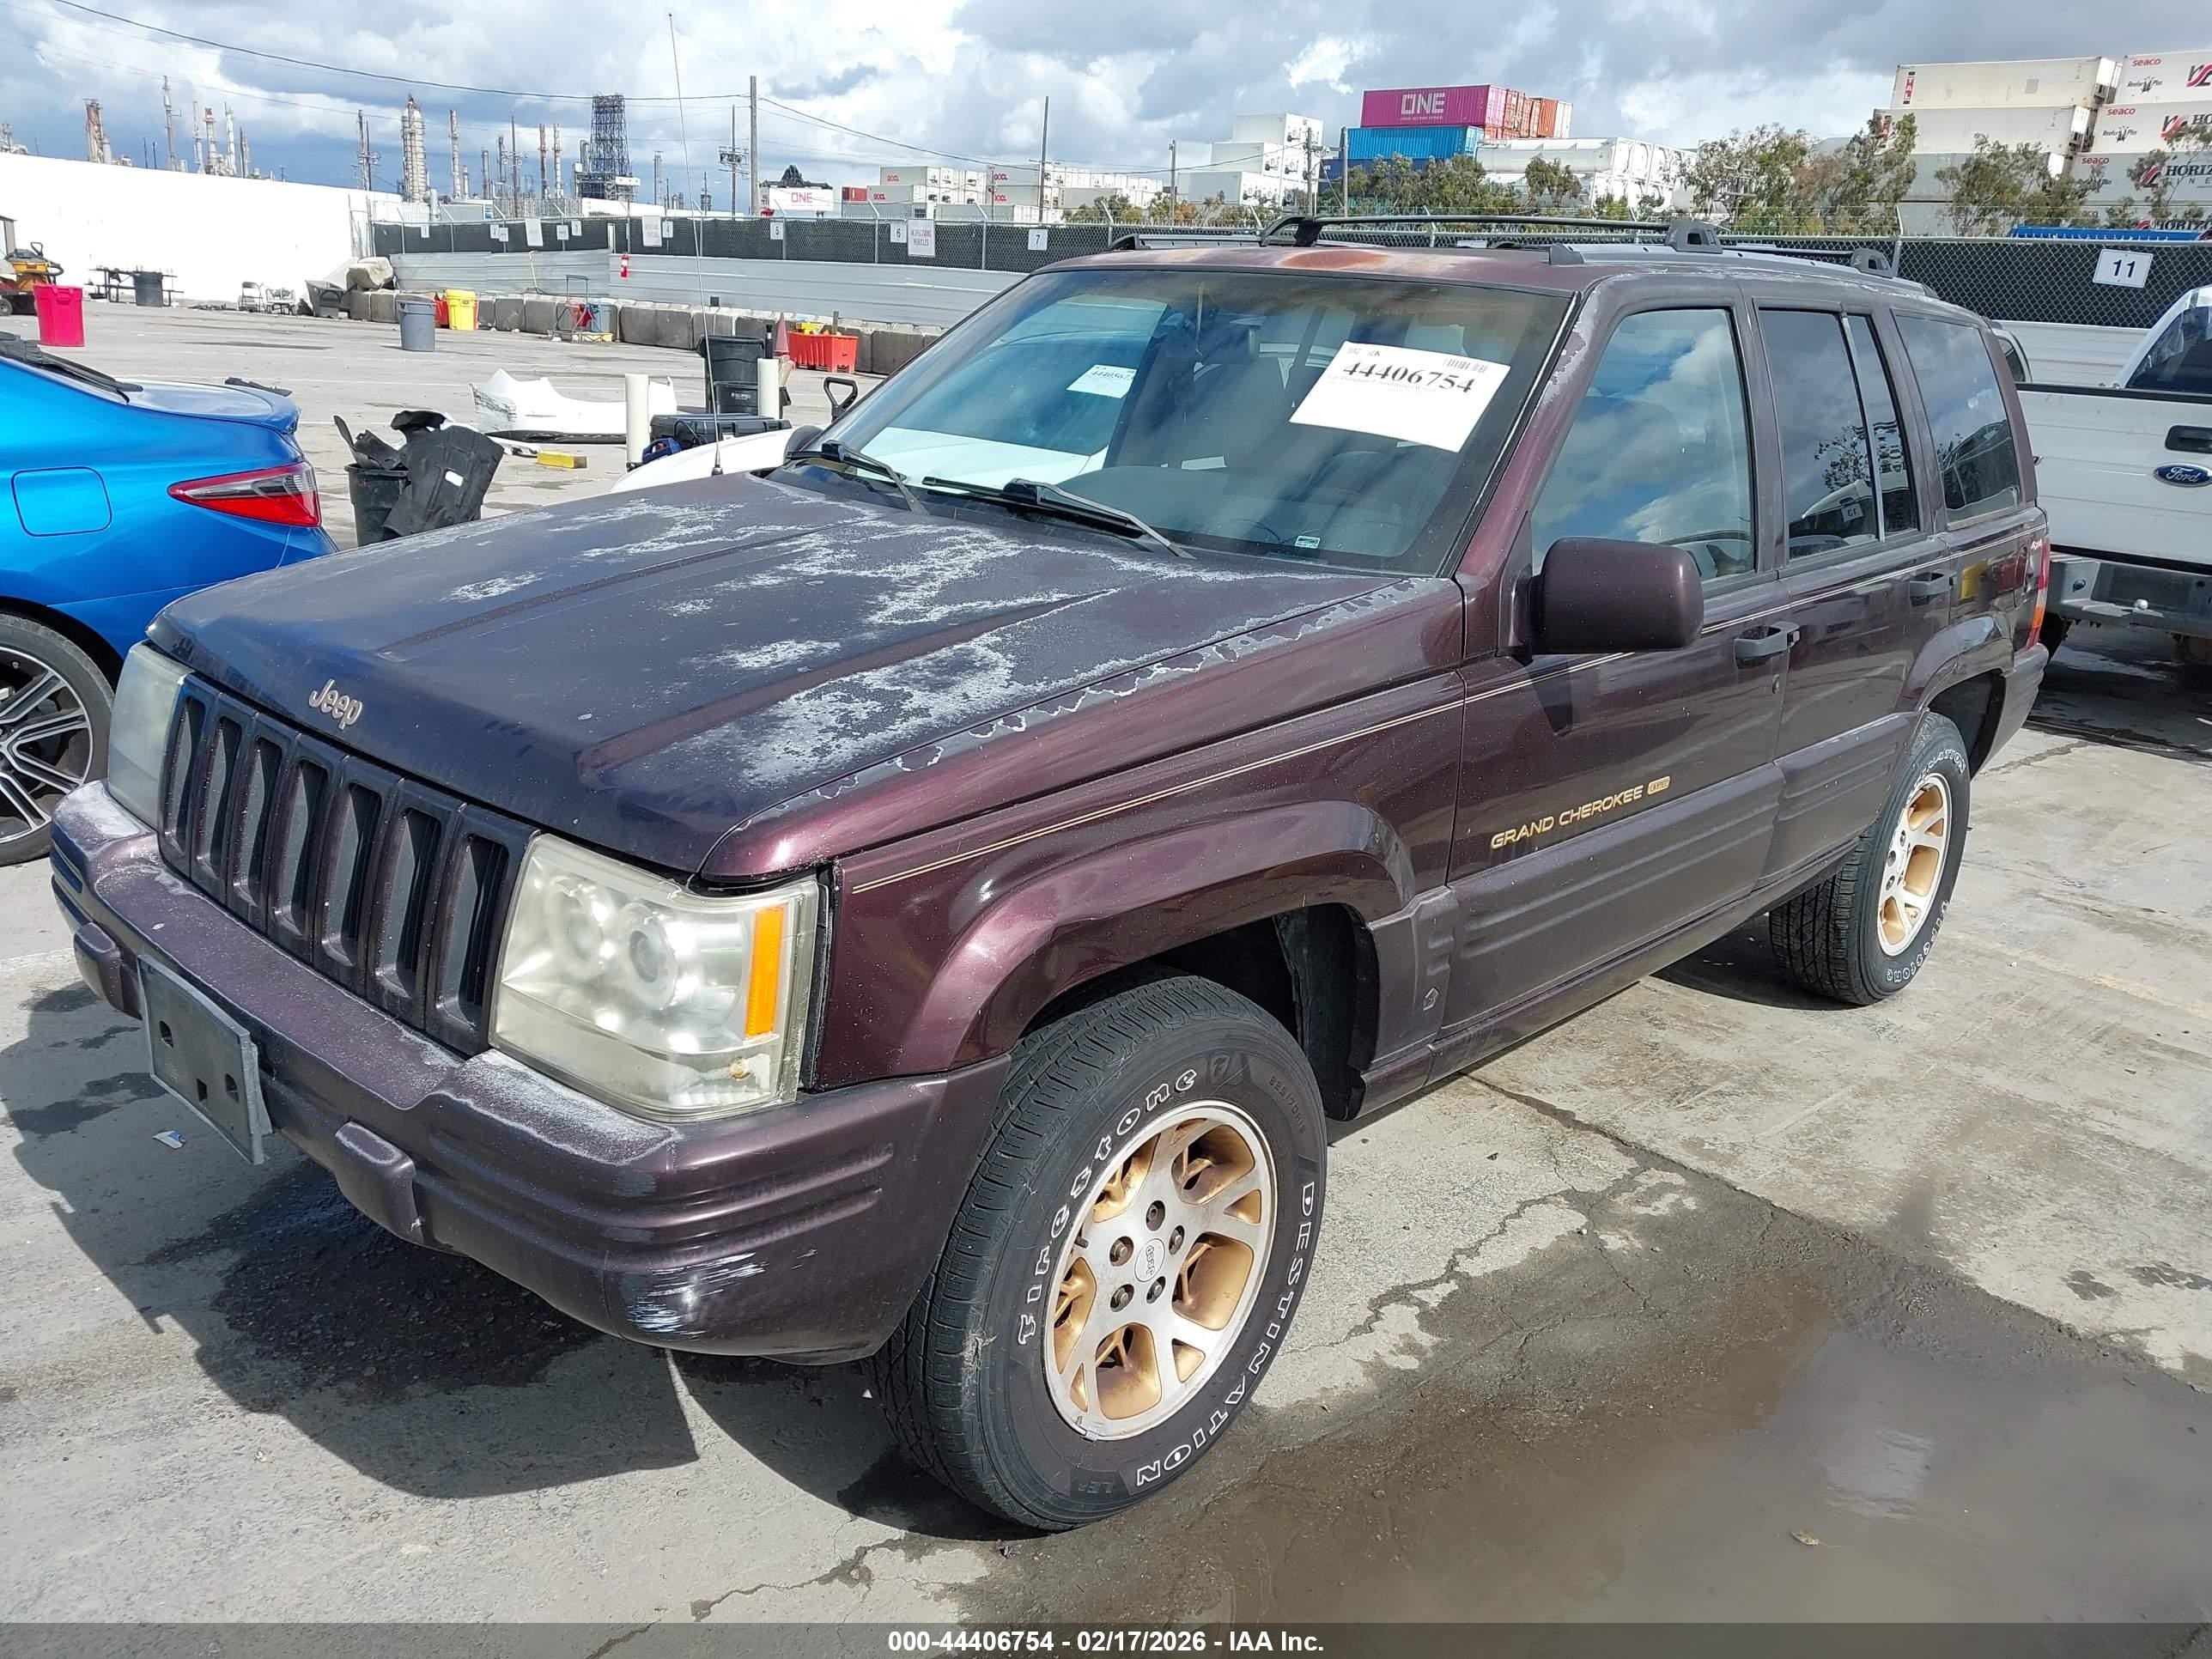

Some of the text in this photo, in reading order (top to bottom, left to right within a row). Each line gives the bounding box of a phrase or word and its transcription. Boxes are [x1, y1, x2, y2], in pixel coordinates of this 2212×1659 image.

[2132, 58, 2161, 67] seaco
[1904, 76, 1915, 100] HAL
[1401, 92, 1445, 114] ONE
[2107, 107, 2136, 116] seaco
[2081, 156, 2110, 165] seaco
[792, 191, 813, 204] ONE
[896, 228, 902, 238] 6
[1035, 234, 1041, 245] 7
[2113, 258, 2136, 278] 11
[1342, 362, 1475, 393] 44406754
[2166, 466, 2202, 483] Ford
[308, 678, 363, 730] Jeep
[1491, 784, 1644, 849] GRAND CHEROKEE
[1146, 1244, 1156, 1276] Jeep
[1135, 1180, 1316, 1487] DESTINATION
